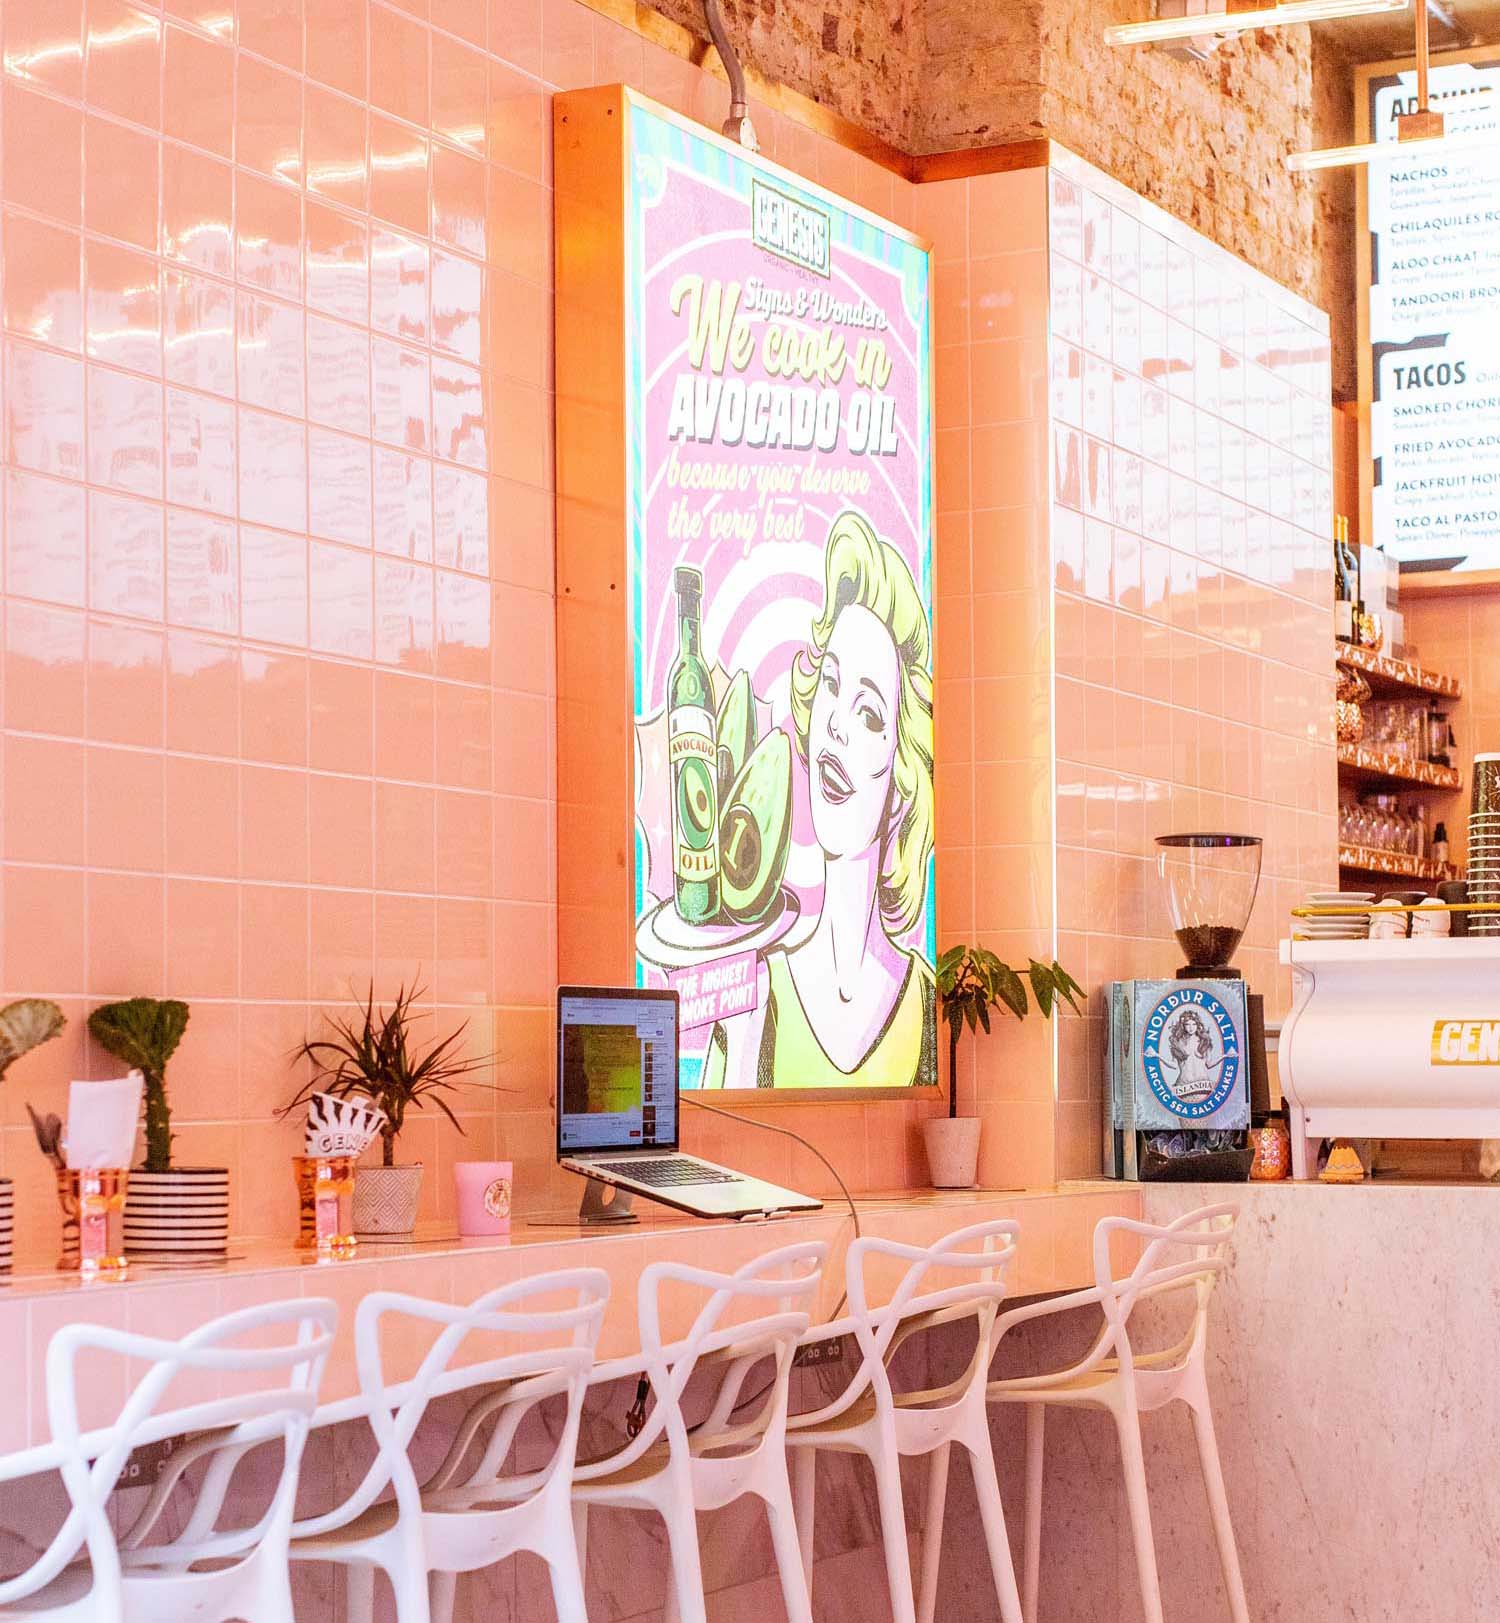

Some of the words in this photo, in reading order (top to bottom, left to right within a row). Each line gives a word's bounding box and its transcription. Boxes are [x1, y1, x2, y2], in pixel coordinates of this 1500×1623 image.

[1390, 167, 1448, 183] NACHOS
[757, 190, 826, 270] GENESIS
[1390, 213, 1480, 234] CHILAQUILES
[1392, 258, 1429, 270] ALOO
[1433, 250, 1477, 266] CHAAT
[745, 277, 793, 321] Signs
[797, 287, 810, 318] &
[811, 288, 889, 332] Wonders
[1392, 291, 1465, 308] TANDOORI
[1469, 286, 1500, 299] BRO
[669, 273, 756, 376] We
[762, 325, 847, 388] cook
[855, 338, 893, 391] in
[1393, 361, 1466, 390] TACOS
[668, 373, 841, 454] AVOCADO
[848, 390, 899, 457] OIL
[1393, 402, 1452, 417] SMOKED
[1394, 441, 1433, 454] FRIED
[667, 445, 751, 491] because
[755, 461, 796, 508] you
[800, 452, 871, 494] deserve
[1394, 475, 1466, 492] JACKFRUIT
[667, 495, 703, 539] the
[710, 508, 757, 557] very
[763, 498, 805, 540] best
[1395, 516, 1431, 528] TACO
[1435, 515, 1449, 525] AL
[1455, 511, 1500, 523] PASTO
[672, 738, 714, 757] AVOCADO
[682, 853, 713, 872] OIL
[676, 972, 699, 1000] THE
[701, 960, 750, 994] HIGHEST
[720, 981, 756, 1013] POINT
[1208, 1001, 1236, 1043] SALT
[1147, 1065, 1171, 1104] ARCTIC
[1169, 1100, 1189, 1116] SEA
[1191, 1099, 1216, 1116] SALT
[1215, 1063, 1235, 1103] FLAKES
[1175, 1080, 1213, 1095] ISLANDIA
